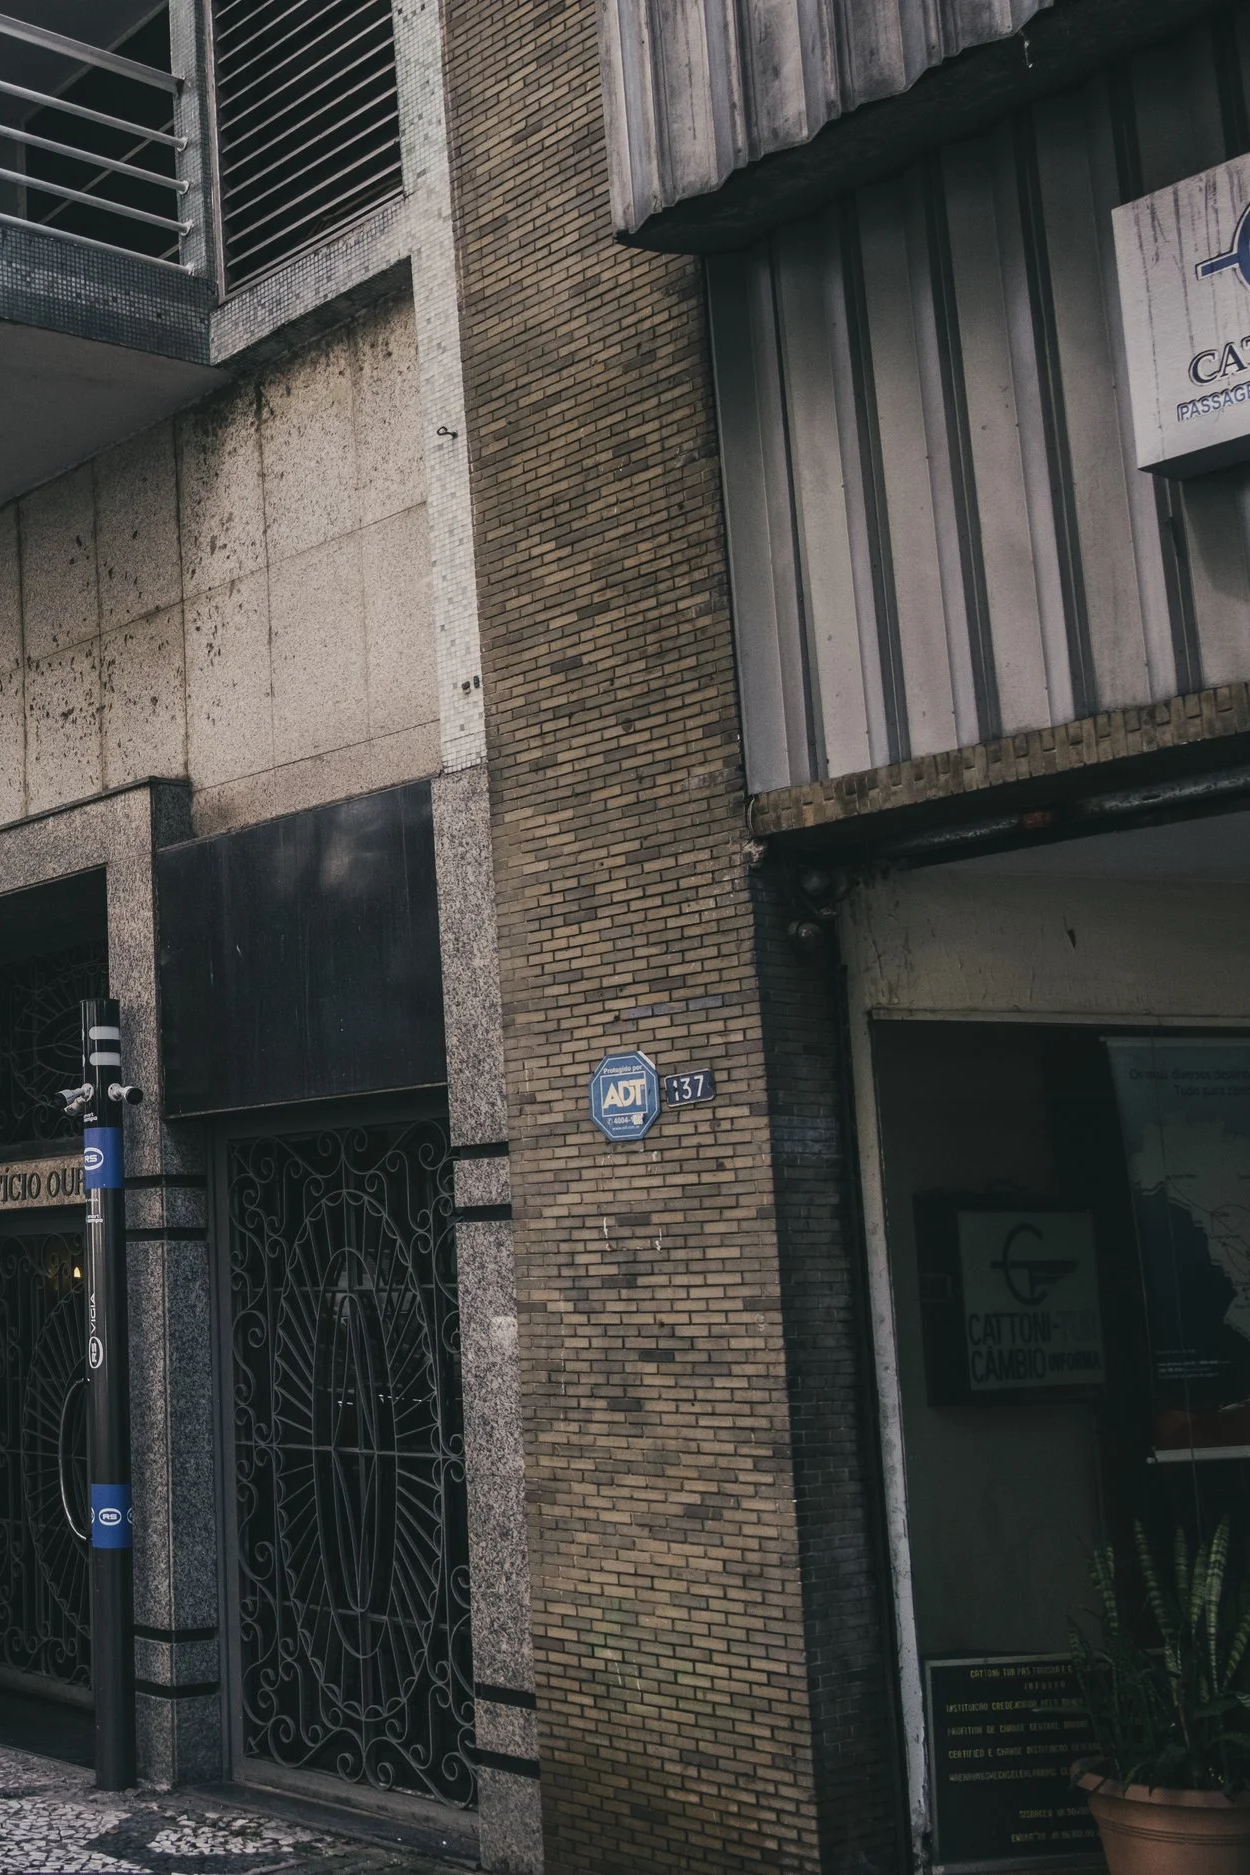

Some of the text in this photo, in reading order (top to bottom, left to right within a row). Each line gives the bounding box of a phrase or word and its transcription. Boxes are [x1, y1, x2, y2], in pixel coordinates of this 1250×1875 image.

[604, 1065, 631, 1074] Protegido
[603, 1079, 646, 1109] ADT
[1049, 1351, 1102, 1372] INFORMA
